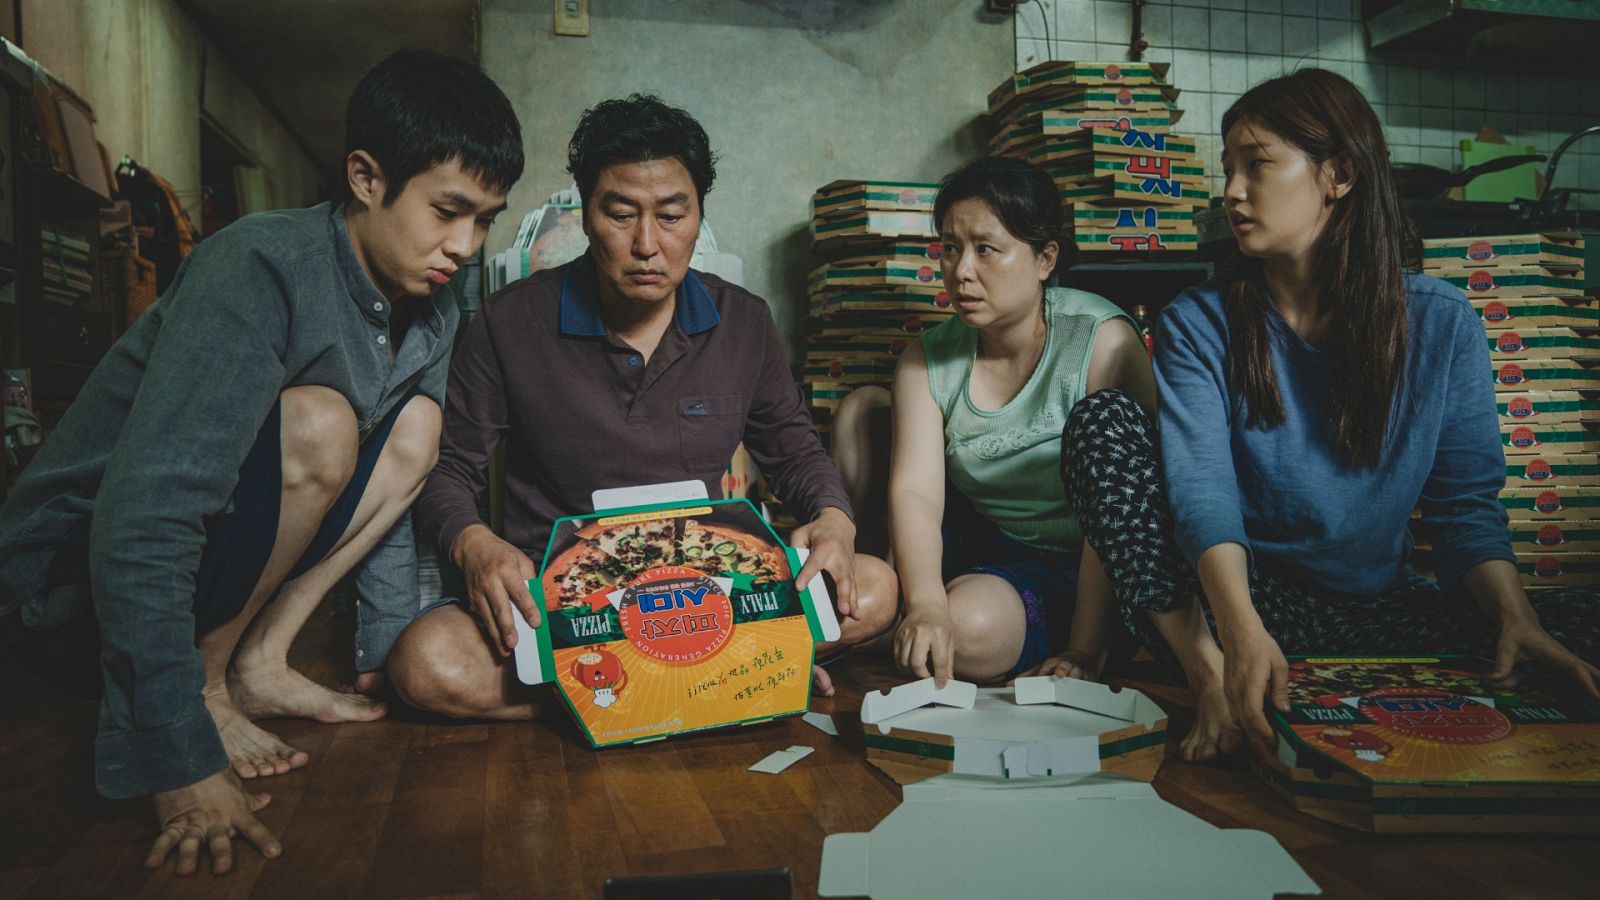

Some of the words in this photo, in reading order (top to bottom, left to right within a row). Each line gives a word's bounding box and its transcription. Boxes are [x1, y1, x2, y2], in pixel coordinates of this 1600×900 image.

[698, 575, 722, 596] SINCE
[621, 603, 631, 630] FRESH
[655, 567, 686, 576] PIZZA
[637, 587, 710, 614] 시대
[742, 591, 779, 615] ITALY
[571, 612, 612, 638] PIZZA
[640, 612, 720, 641] 피자
[635, 640, 702, 662] GENERATION
[705, 629, 727, 652] PIZZA
[1302, 707, 1356, 721] PIZZA
